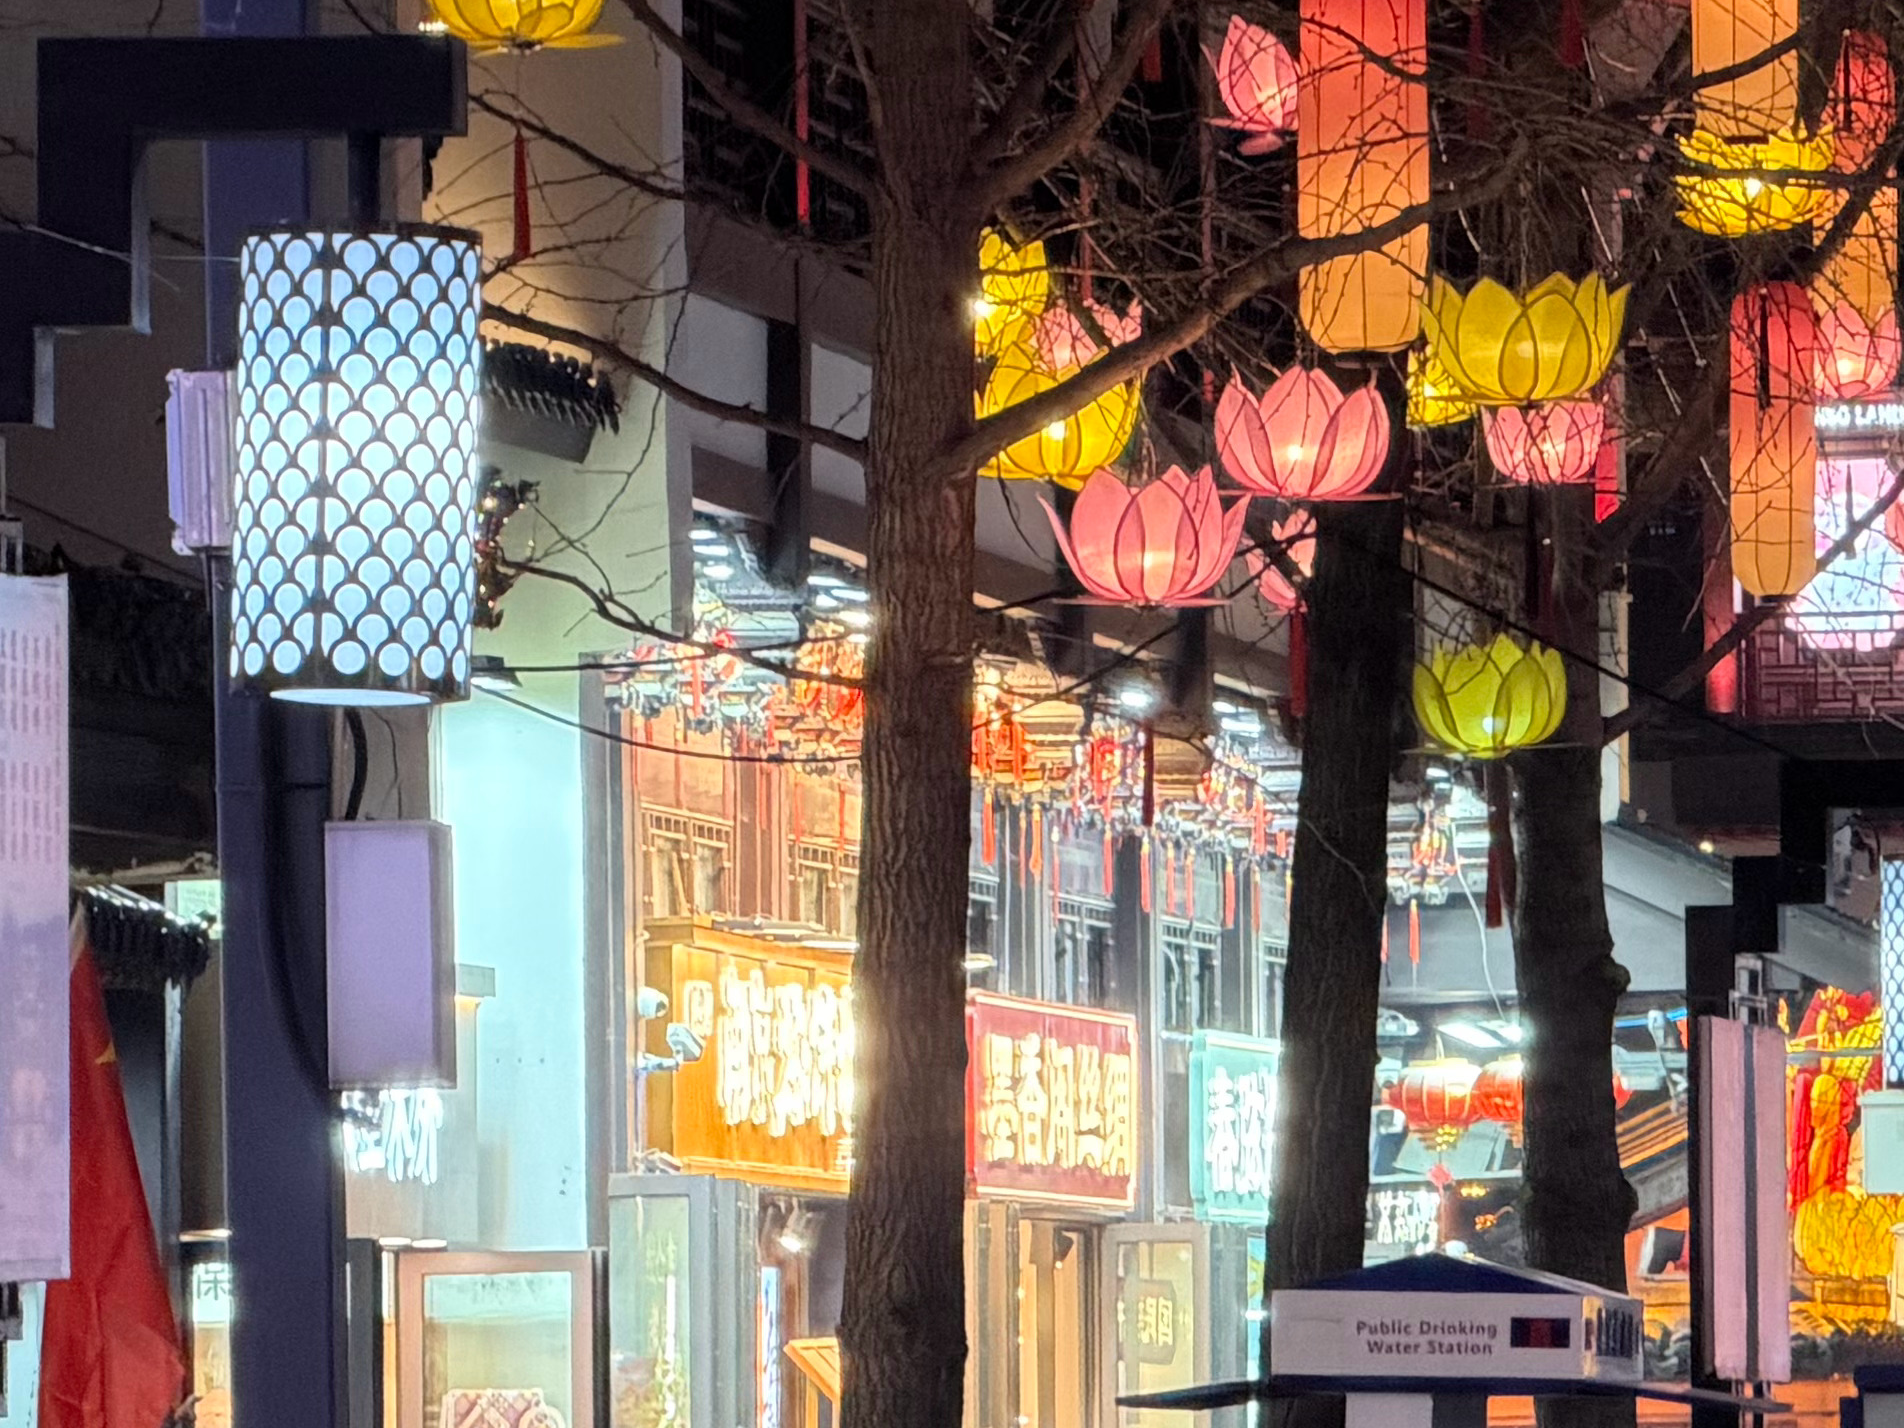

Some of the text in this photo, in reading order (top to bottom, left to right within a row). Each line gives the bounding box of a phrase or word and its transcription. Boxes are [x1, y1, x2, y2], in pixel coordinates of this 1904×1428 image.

[1356, 1321, 1498, 1340] Public Drinking
[1367, 1339, 1493, 1355] Water Station
